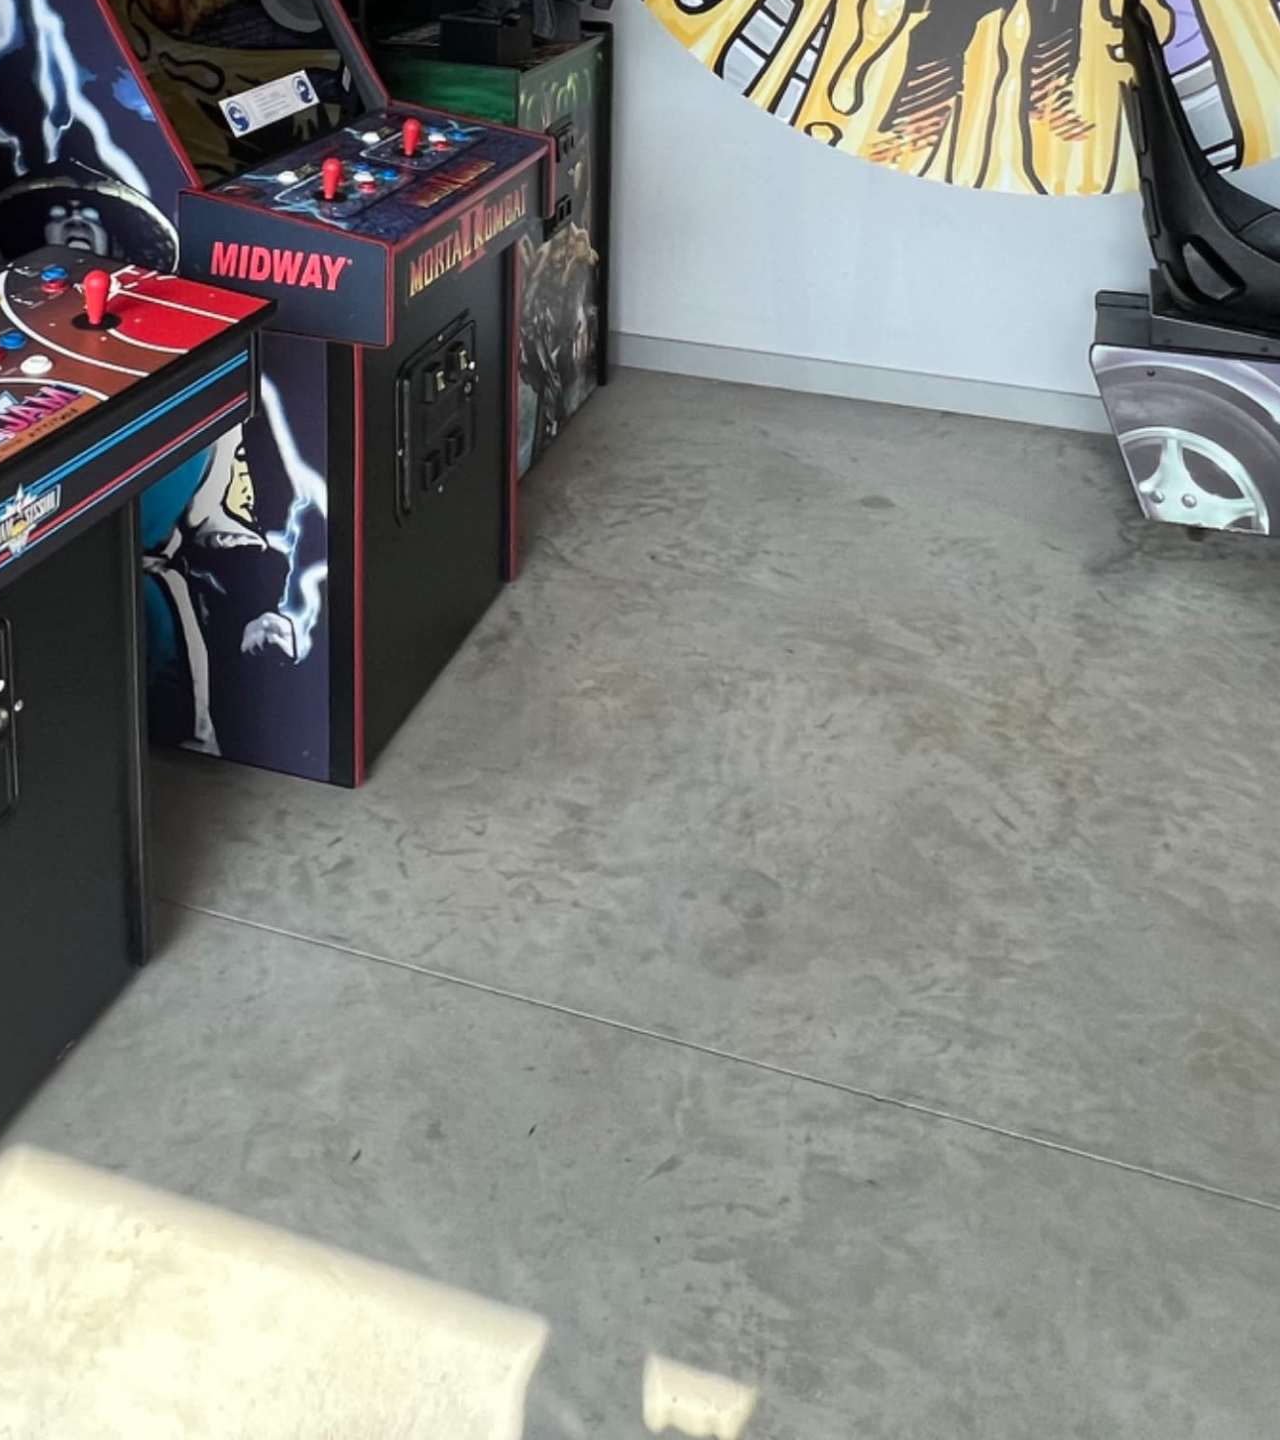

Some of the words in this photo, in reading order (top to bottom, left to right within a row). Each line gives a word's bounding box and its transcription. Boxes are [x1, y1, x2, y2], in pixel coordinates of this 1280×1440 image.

[210, 241, 348, 292] MIDWAY
[409, 227, 473, 298] MORTAL
[474, 182, 529, 251] KOMBAT
